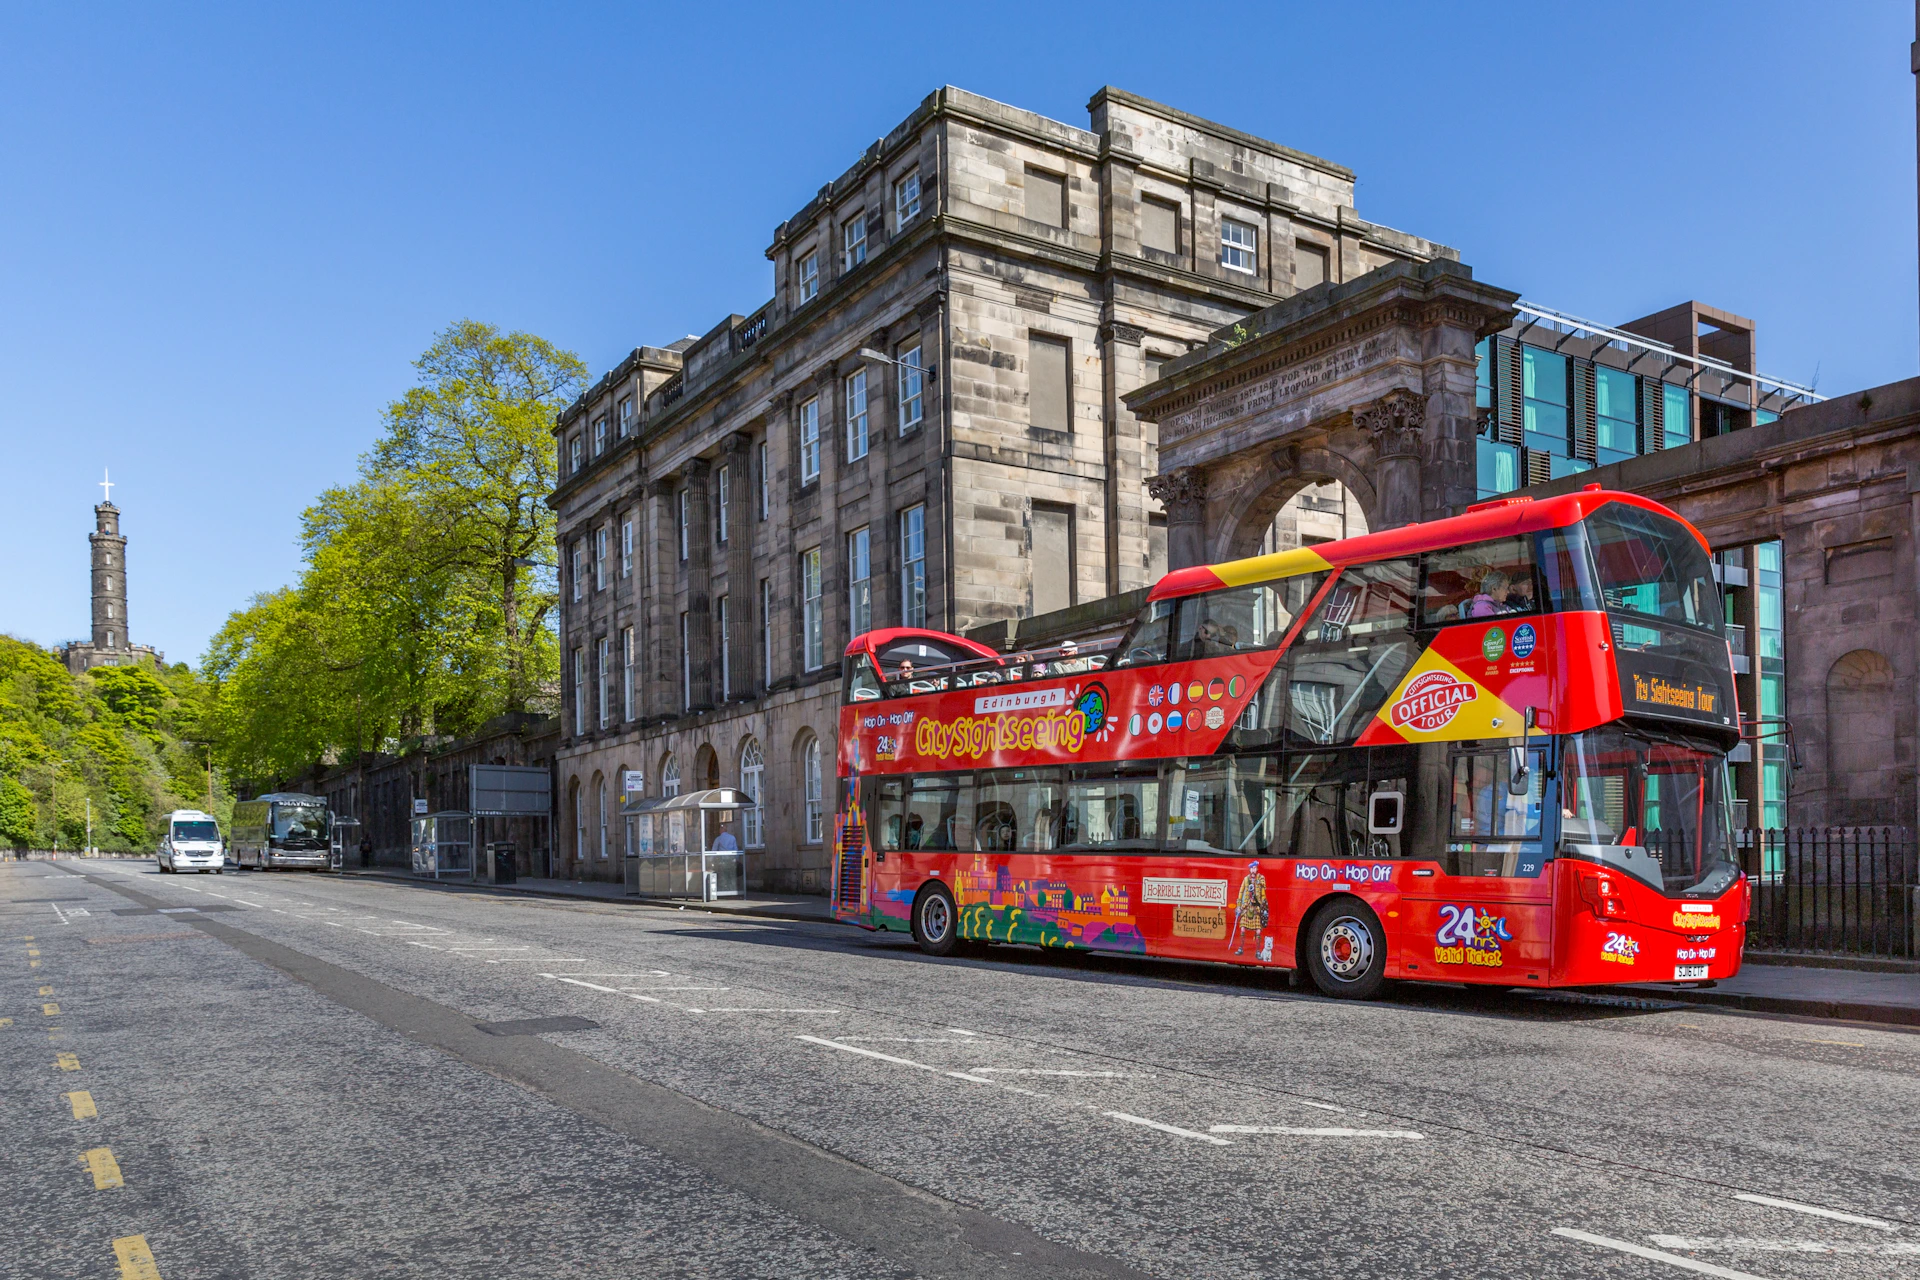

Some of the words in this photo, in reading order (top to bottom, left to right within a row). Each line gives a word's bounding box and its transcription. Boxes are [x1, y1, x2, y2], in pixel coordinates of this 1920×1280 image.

[1205, 394, 1238, 415] AUGUST
[1260, 378, 1278, 393] 1819
[1281, 370, 1300, 385] FOR
[1303, 362, 1322, 375] THE
[1326, 346, 1360, 366] ENTRY
[1174, 421, 1201, 438] ROYAL
[1203, 405, 1245, 428] HIGHNESS
[1247, 391, 1277, 410] PRINCE
[1280, 375, 1318, 398] LEOPOLD
[1408, 674, 1454, 696] CITYSIGHTSEEING
[1650, 677, 1695, 709] Sightseeing
[1696, 686, 1715, 713] Tour
[982, 692, 1057, 710] Edinburgh
[1398, 685, 1473, 721] OFFICIAL
[864, 716, 877, 729] Hop
[877, 714, 886, 727] On
[890, 712, 903, 726] Hop
[903, 710, 915, 724] Off
[1421, 708, 1454, 728] TOUR
[876, 735, 889, 754] 24
[915, 708, 1086, 760] CitySightseeing
[1296, 863, 1319, 882] Hop
[1320, 863, 1337, 881] On
[1344, 864, 1369, 883] Hop
[1371, 864, 1392, 882] Off
[1522, 863, 1535, 873] 229
[1147, 884, 1181, 898] HORRIBLE
[1183, 884, 1223, 900] HISTORIES
[1175, 909, 1224, 930] Edinburgh
[1182, 923, 1197, 935] Terry
[1197, 924, 1214, 936] Deary
[1436, 903, 1476, 947] 24
[1602, 931, 1627, 955] 24
[1434, 946, 1465, 965] Valid
[1465, 946, 1503, 967] Ticket
[1676, 948, 1689, 961] Hop
[1688, 947, 1697, 960] On
[1698, 948, 1709, 960] Hop
